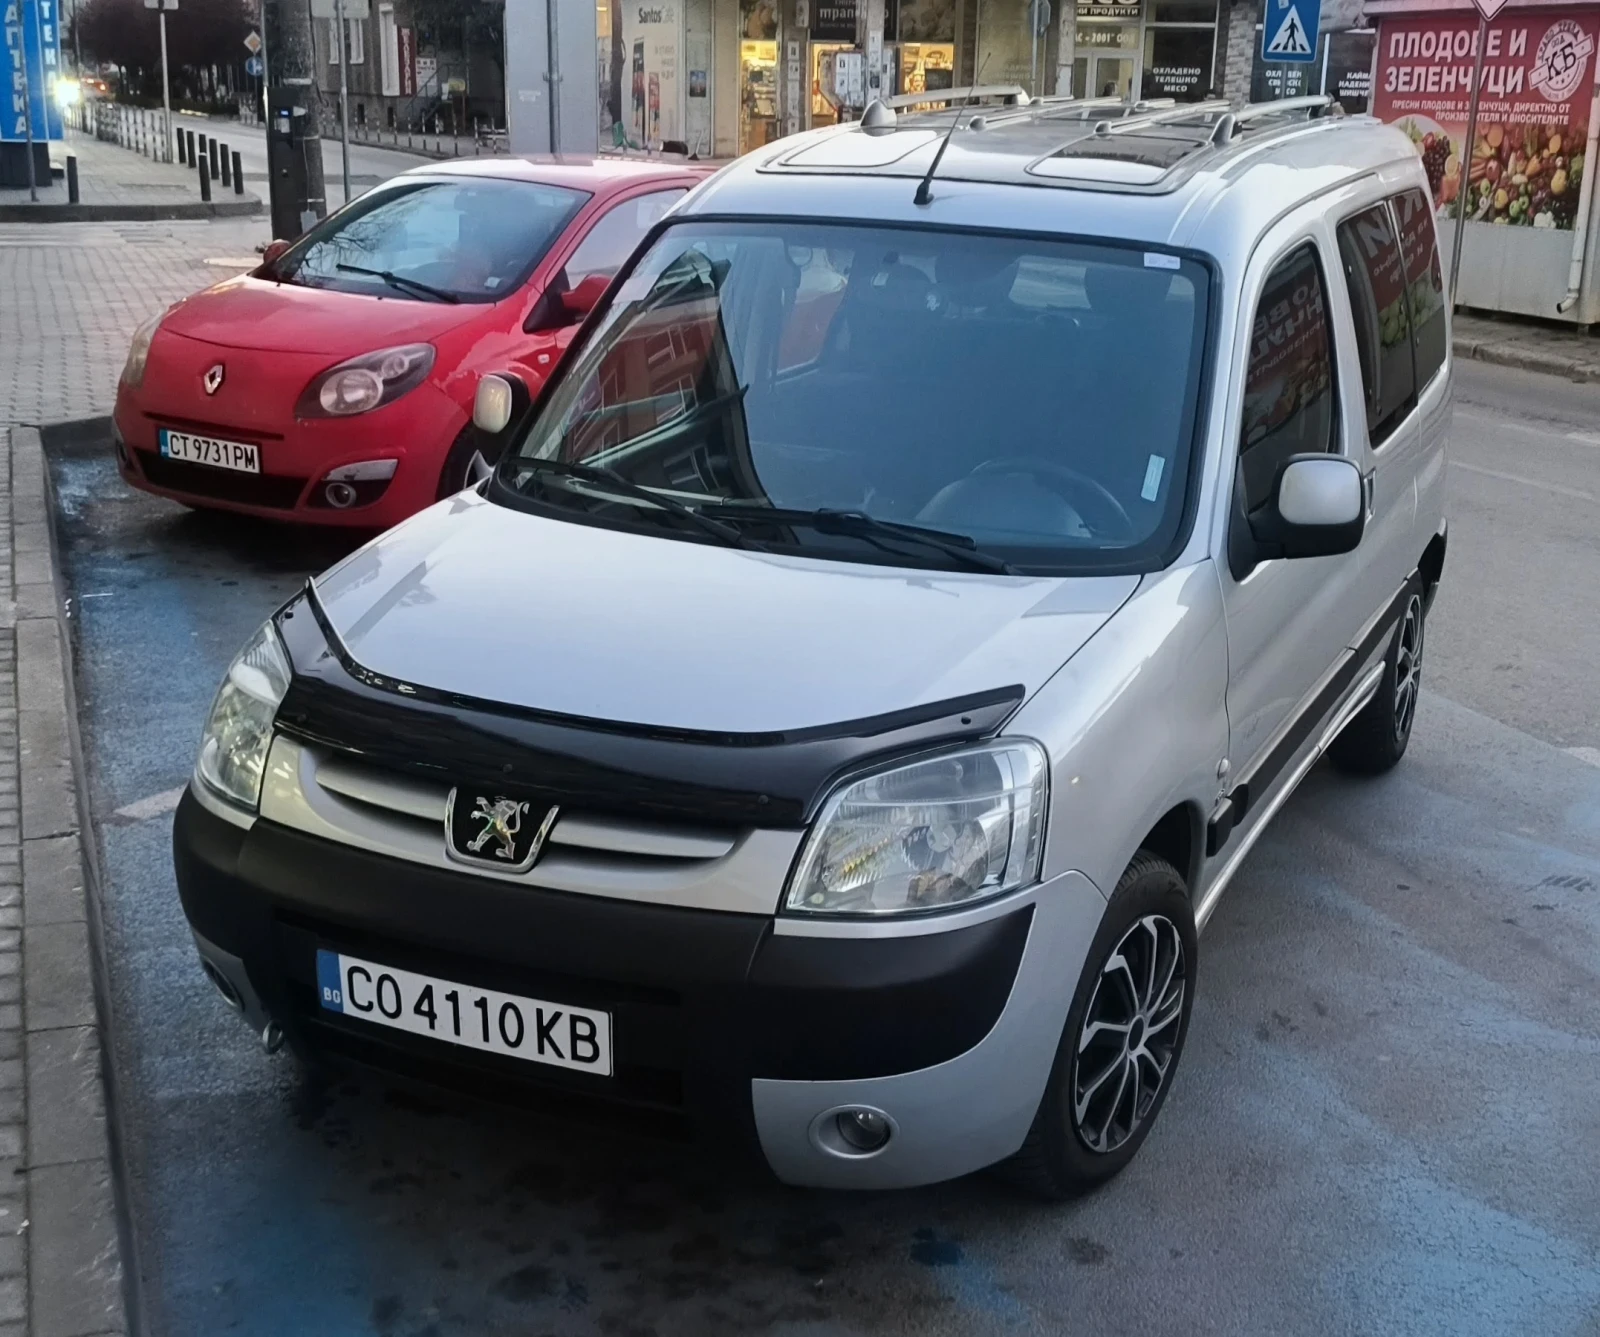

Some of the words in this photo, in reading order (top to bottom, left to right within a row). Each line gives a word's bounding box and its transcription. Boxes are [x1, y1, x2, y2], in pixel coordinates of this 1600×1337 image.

[639, 7, 662, 23] Santos
[1090, 7, 1138, 16] ПРОДУКТИ
[1509, 28, 1528, 57] И
[4, 4, 31, 134] АПТЕКА
[1153, 67, 1201, 75] ОХЛАДЕНО
[1155, 76, 1198, 84] ТЕЛЕШКО
[1392, 100, 1420, 109] ПРЕСНИ
[1421, 100, 1456, 110] ПЛОДОВЕ
[1457, 101, 1463, 110] И
[1513, 102, 1557, 113] ДИРЕКТНО
[1558, 103, 1571, 114] ОТ
[1501, 113, 1508, 122] И
[1509, 113, 1569, 125] ВНОСИТЕЛИТЕ
[193, 438, 229, 466] 9731
[323, 986, 342, 1004] BG
[413, 984, 524, 1048] 4110
